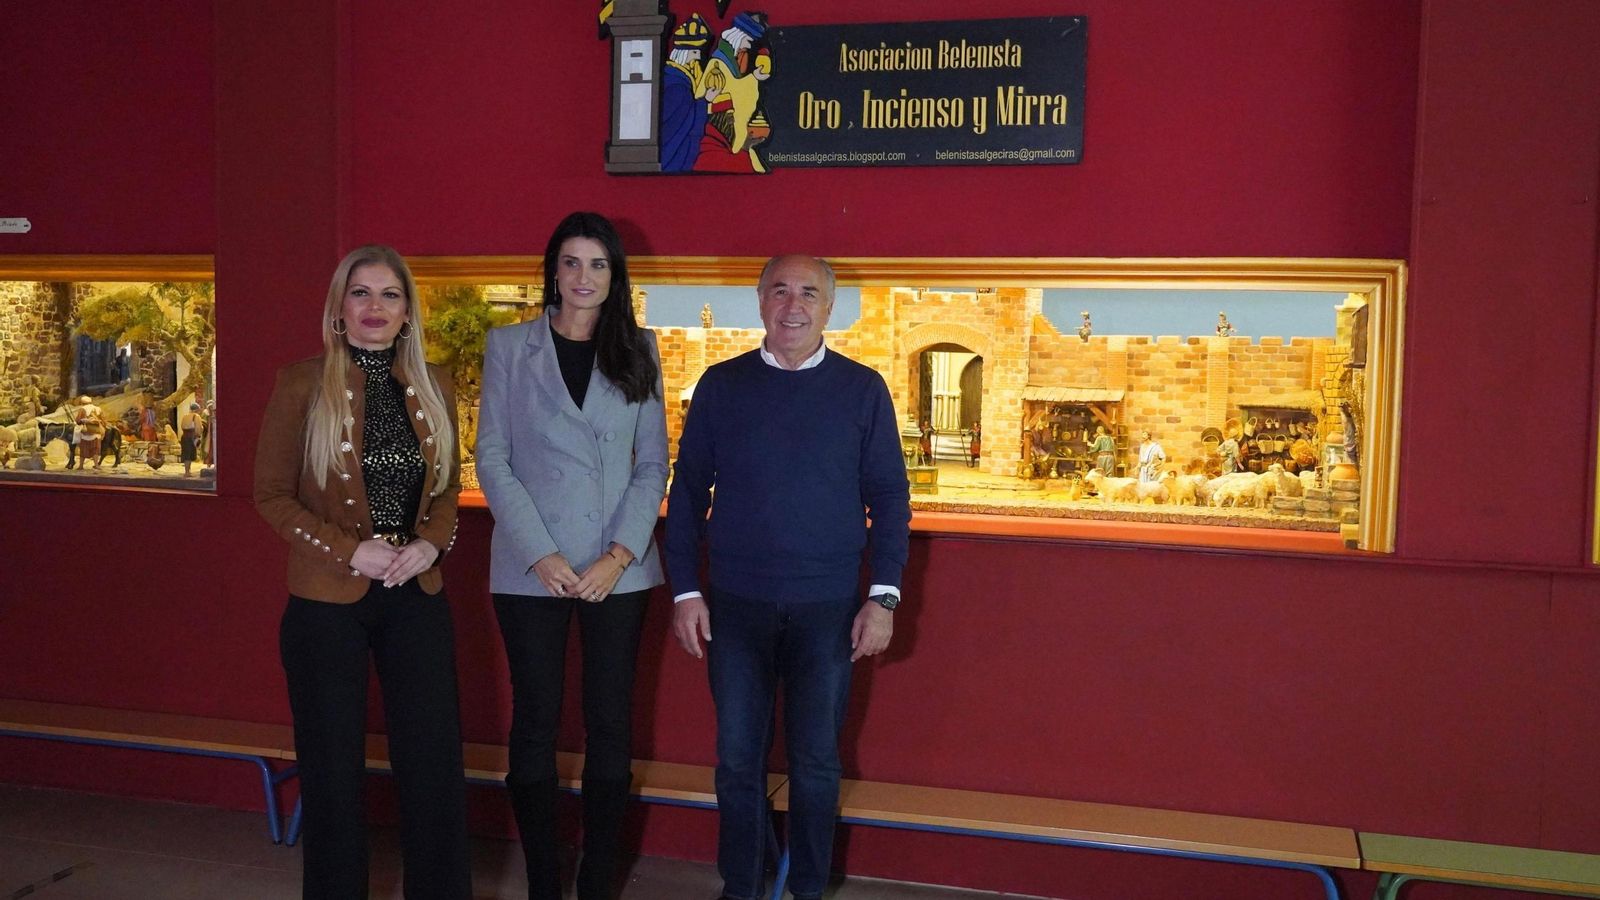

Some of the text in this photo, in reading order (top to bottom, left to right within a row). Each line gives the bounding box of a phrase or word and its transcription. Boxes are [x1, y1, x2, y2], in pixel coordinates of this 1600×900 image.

[839, 39, 1022, 73] Asociacion Belenista
[861, 88, 965, 130] Incienso
[972, 96, 988, 135] y
[996, 86, 1068, 126] Mirra
[768, 150, 906, 164] belenistasalgeciras.blogspot.com
[935, 148, 1075, 162] belenistasalgeciras@gmail.com
